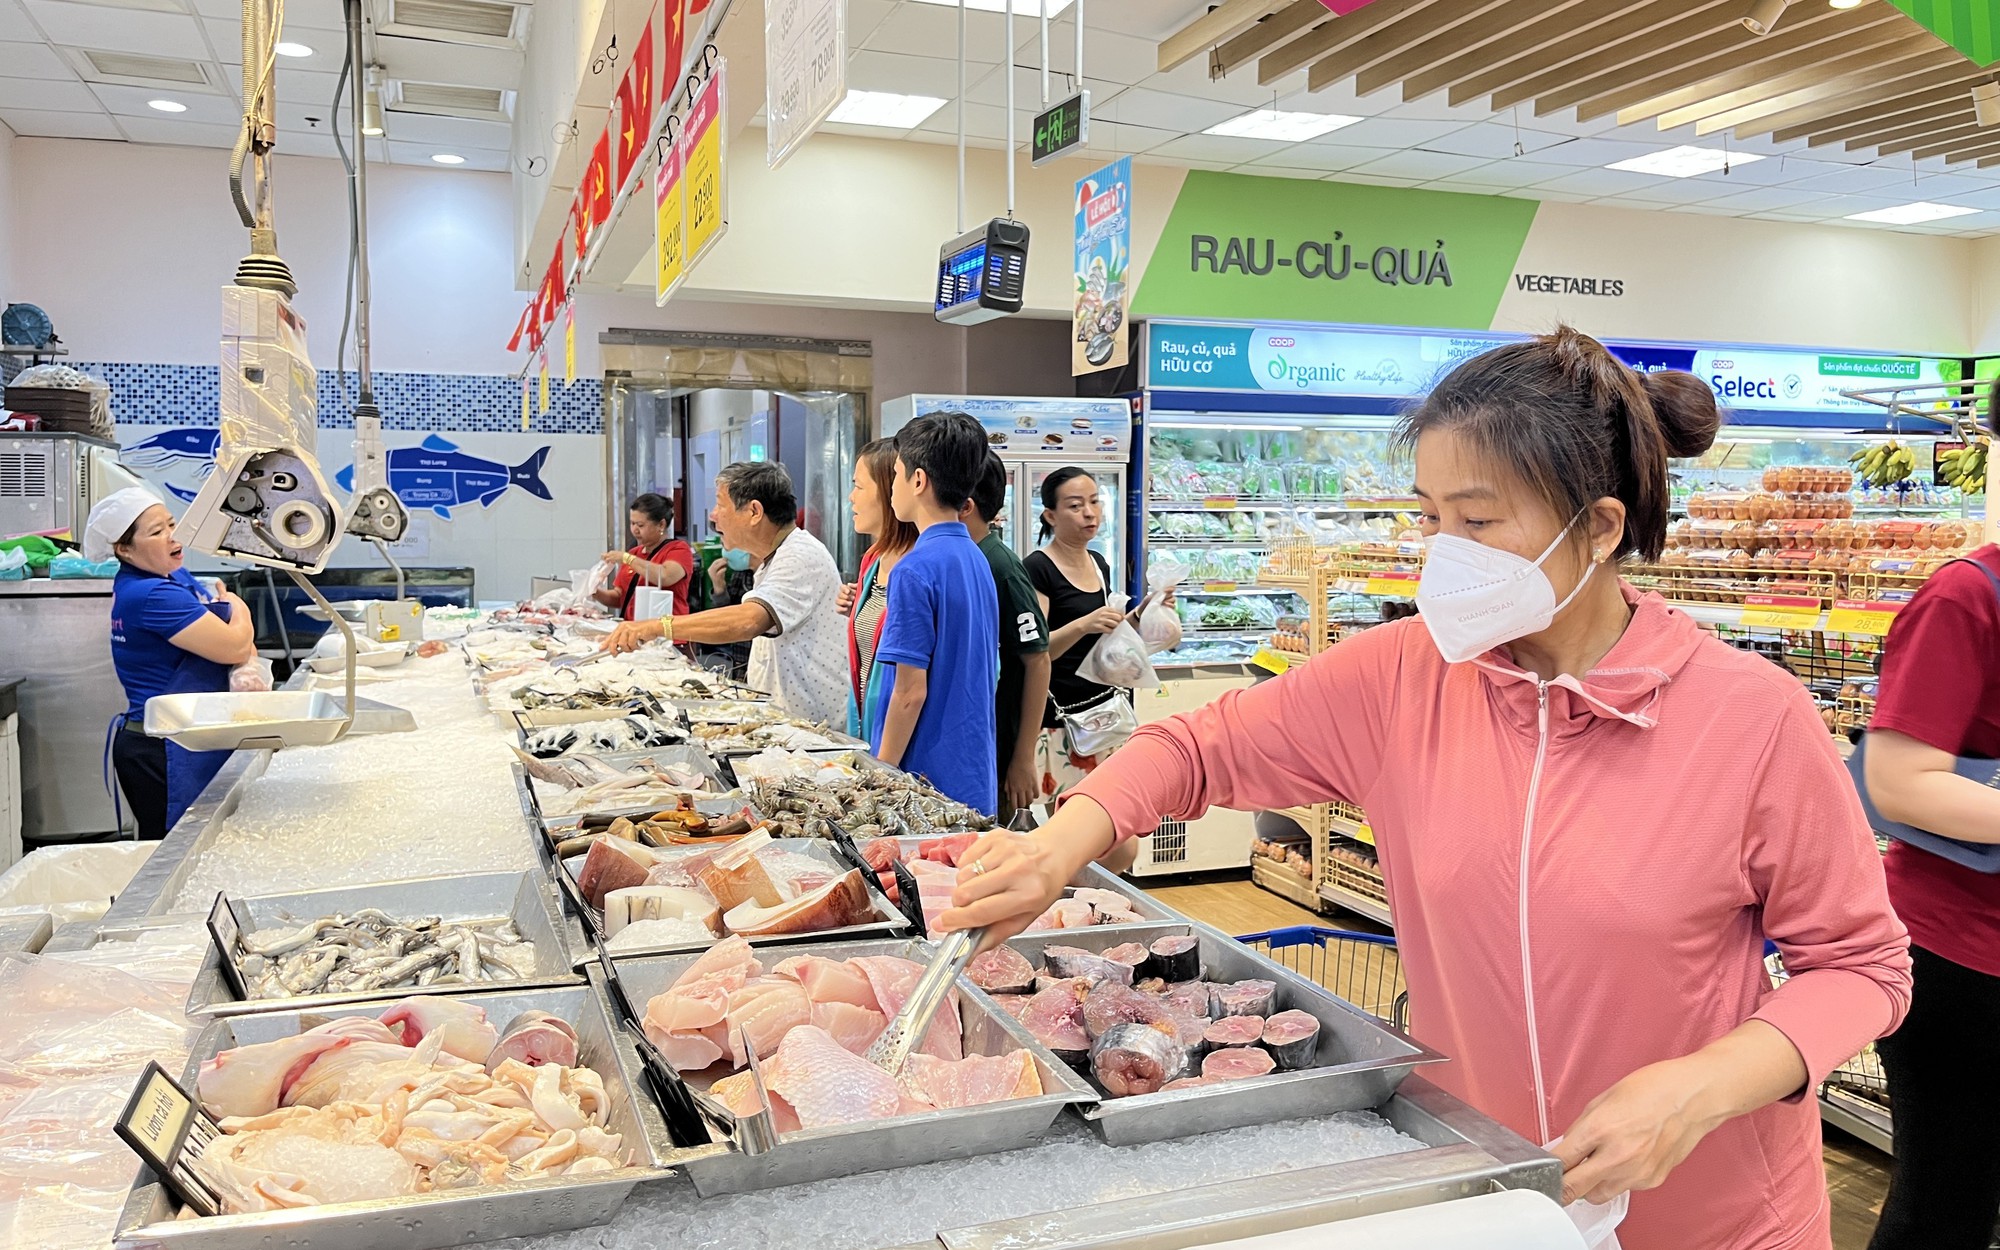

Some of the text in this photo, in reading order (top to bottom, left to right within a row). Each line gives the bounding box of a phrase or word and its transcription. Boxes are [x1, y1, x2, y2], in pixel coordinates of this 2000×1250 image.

[1063, 125, 1078, 141] EXIT
[1191, 231, 1452, 287] RAU-CỦ-QUẢ
[1516, 274, 1624, 297] VEGETABLES
[1161, 340, 1236, 358] Rau, củ, quả
[1269, 338, 1295, 347] COOP
[1161, 357, 1213, 373] HỮU CƠ
[1268, 353, 1345, 388] Organic
[1712, 360, 1734, 369] COOP
[1881, 361, 1904, 375] QUỐC
[1905, 362, 1916, 375] TẾ
[1712, 375, 1776, 398] Select
[1501, 601, 1514, 611] AN
[1017, 612, 1040, 642] 2
[141, 1088, 175, 1142] Lườn cá hồi
